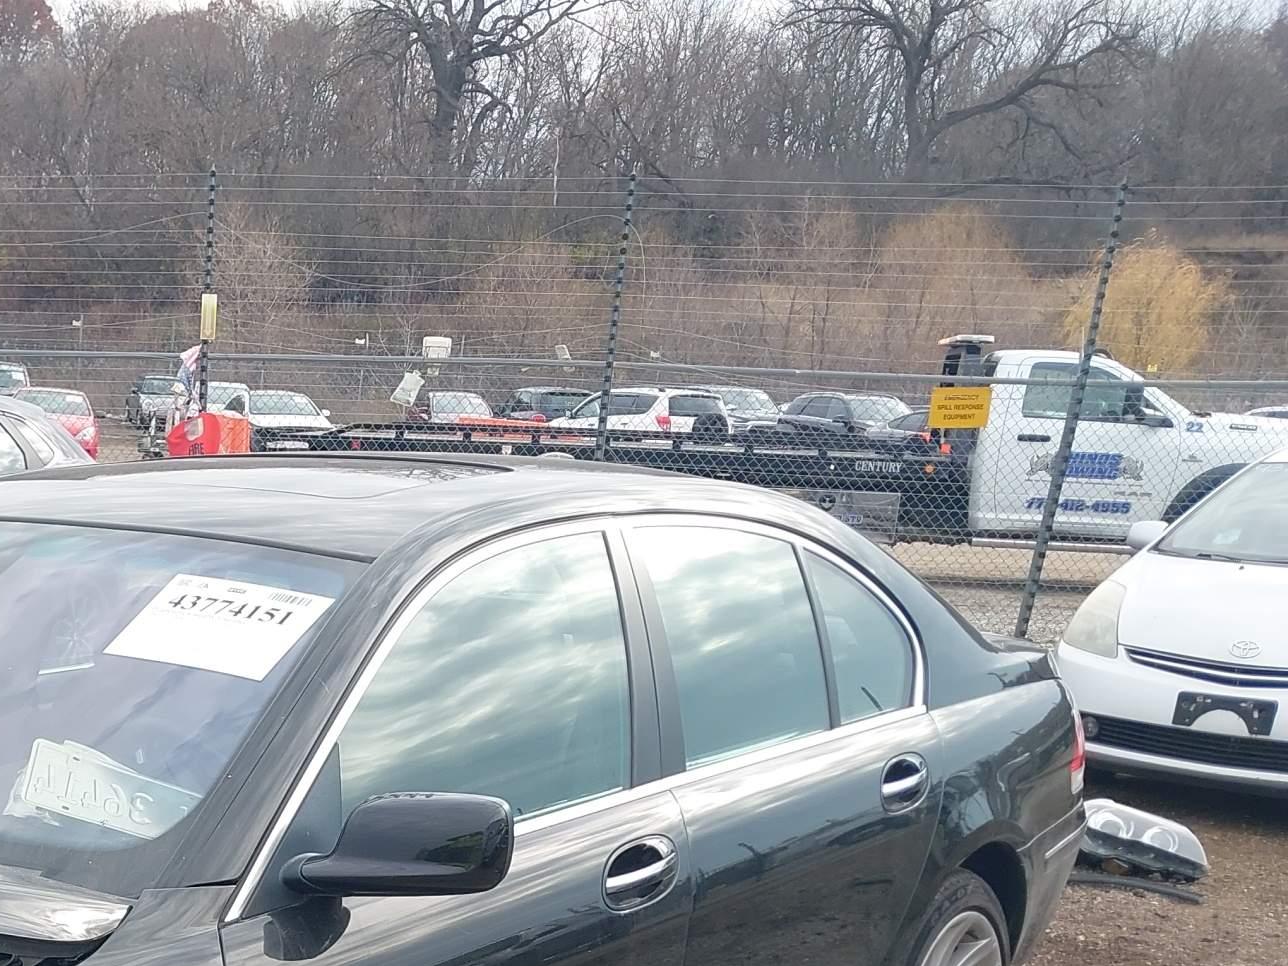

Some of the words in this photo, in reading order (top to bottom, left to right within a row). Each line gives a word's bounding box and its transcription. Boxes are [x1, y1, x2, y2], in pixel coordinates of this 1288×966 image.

[944, 413, 976, 421] EQUIPMENT
[1186, 421, 1204, 433] 22
[1067, 452, 1122, 464] HINOS
[855, 460, 902, 473] CENTURY
[1064, 465, 1120, 479] OWING
[1025, 496, 1131, 514] 77-412-4955
[168, 593, 294, 625] 43774151
